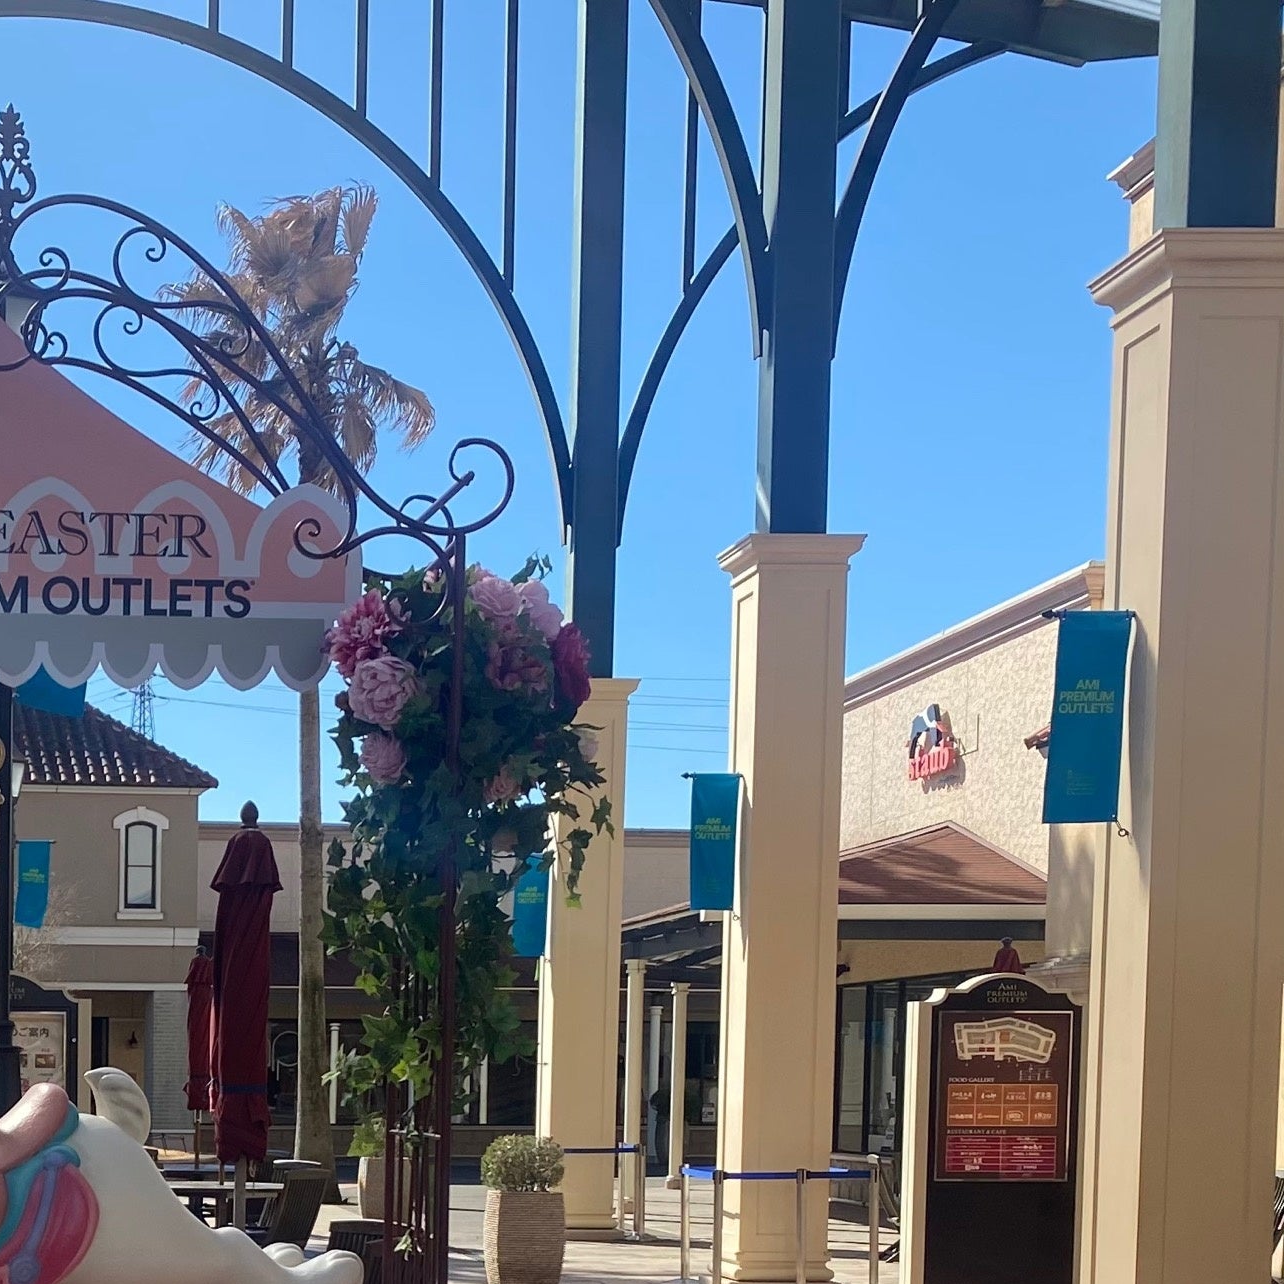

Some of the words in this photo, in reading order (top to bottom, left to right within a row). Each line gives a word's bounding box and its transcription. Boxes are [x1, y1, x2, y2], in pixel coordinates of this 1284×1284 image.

[42, 576, 251, 618] OUTLETS
[1076, 679, 1100, 690] AMI
[1059, 691, 1115, 702] PREMIUM
[1058, 703, 1114, 714] OUTLETS
